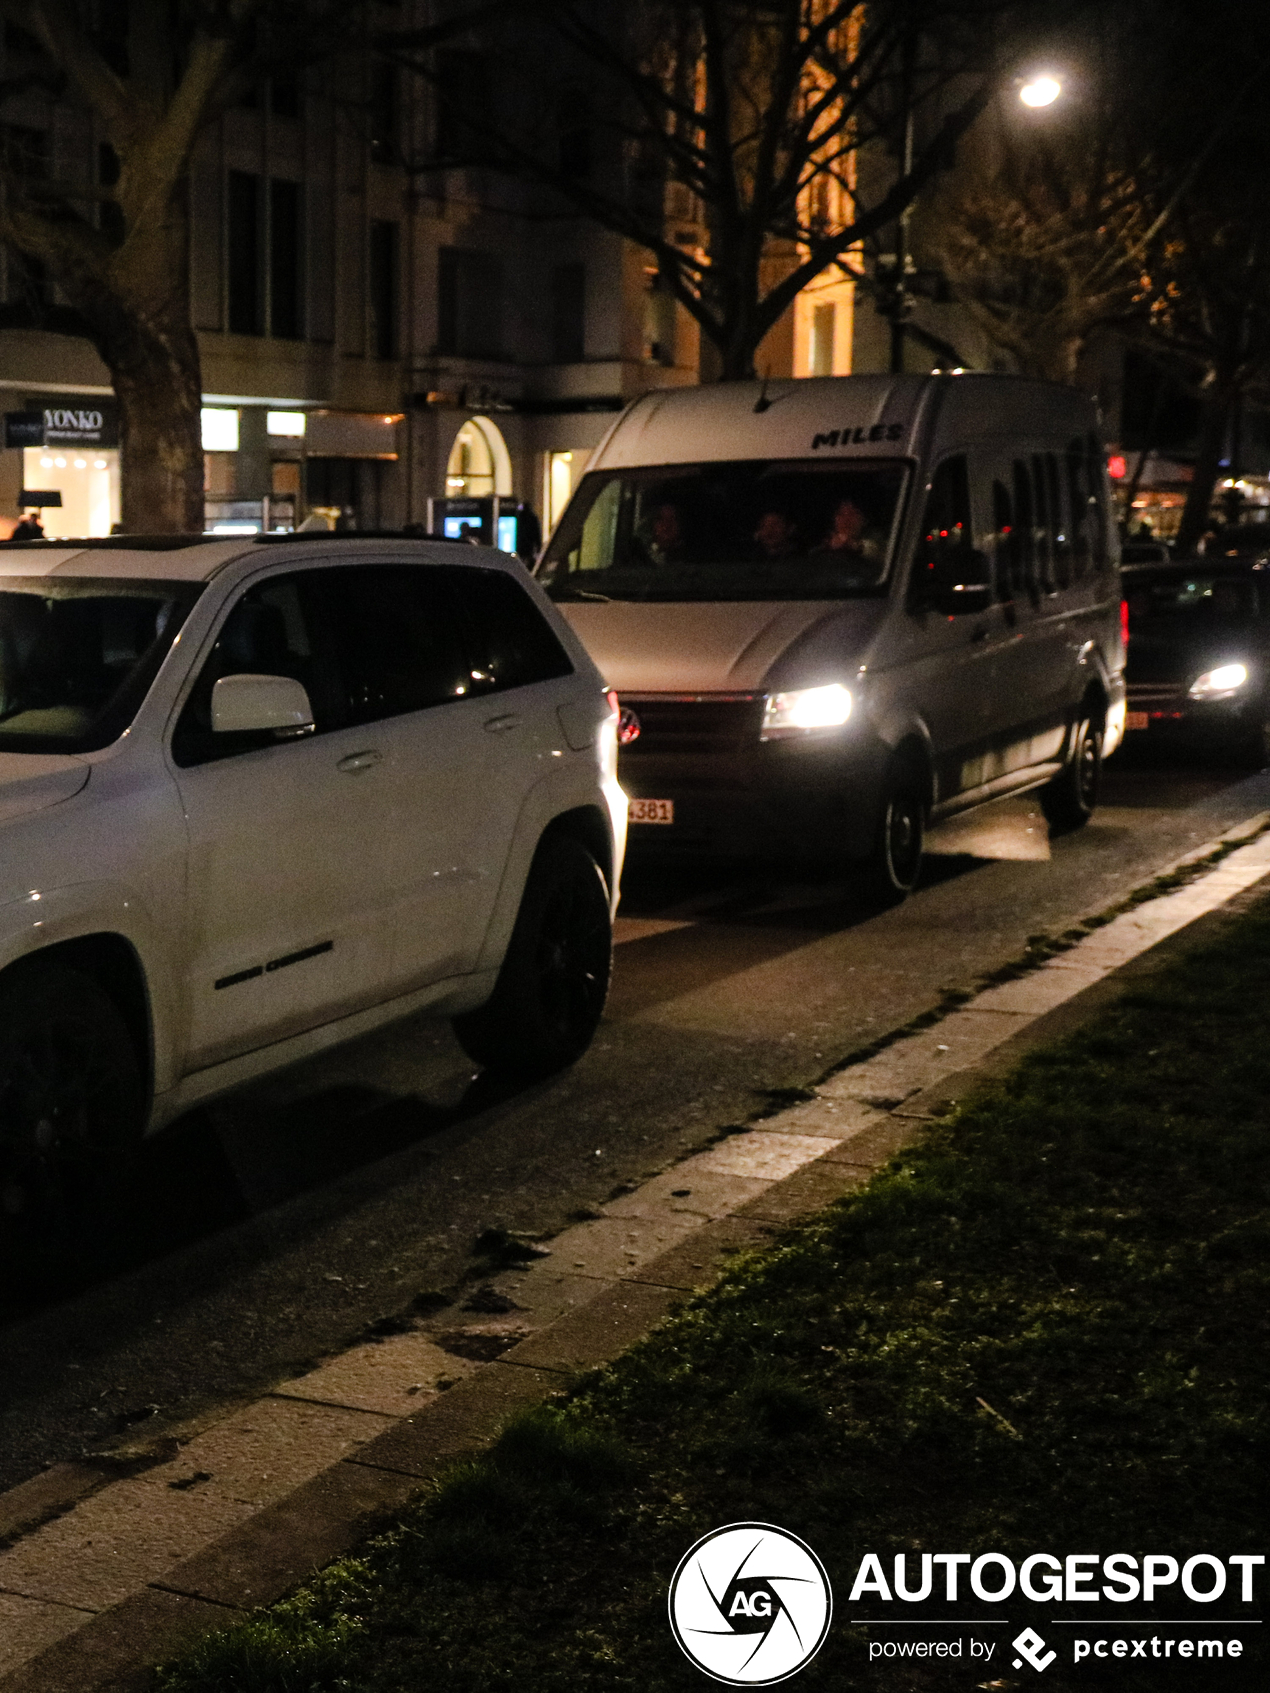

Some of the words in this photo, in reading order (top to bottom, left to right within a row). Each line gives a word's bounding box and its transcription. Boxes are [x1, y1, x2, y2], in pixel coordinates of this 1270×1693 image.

[44, 409, 104, 430] YONKO
[811, 423, 904, 450] MILES
[628, 801, 670, 821] 381
